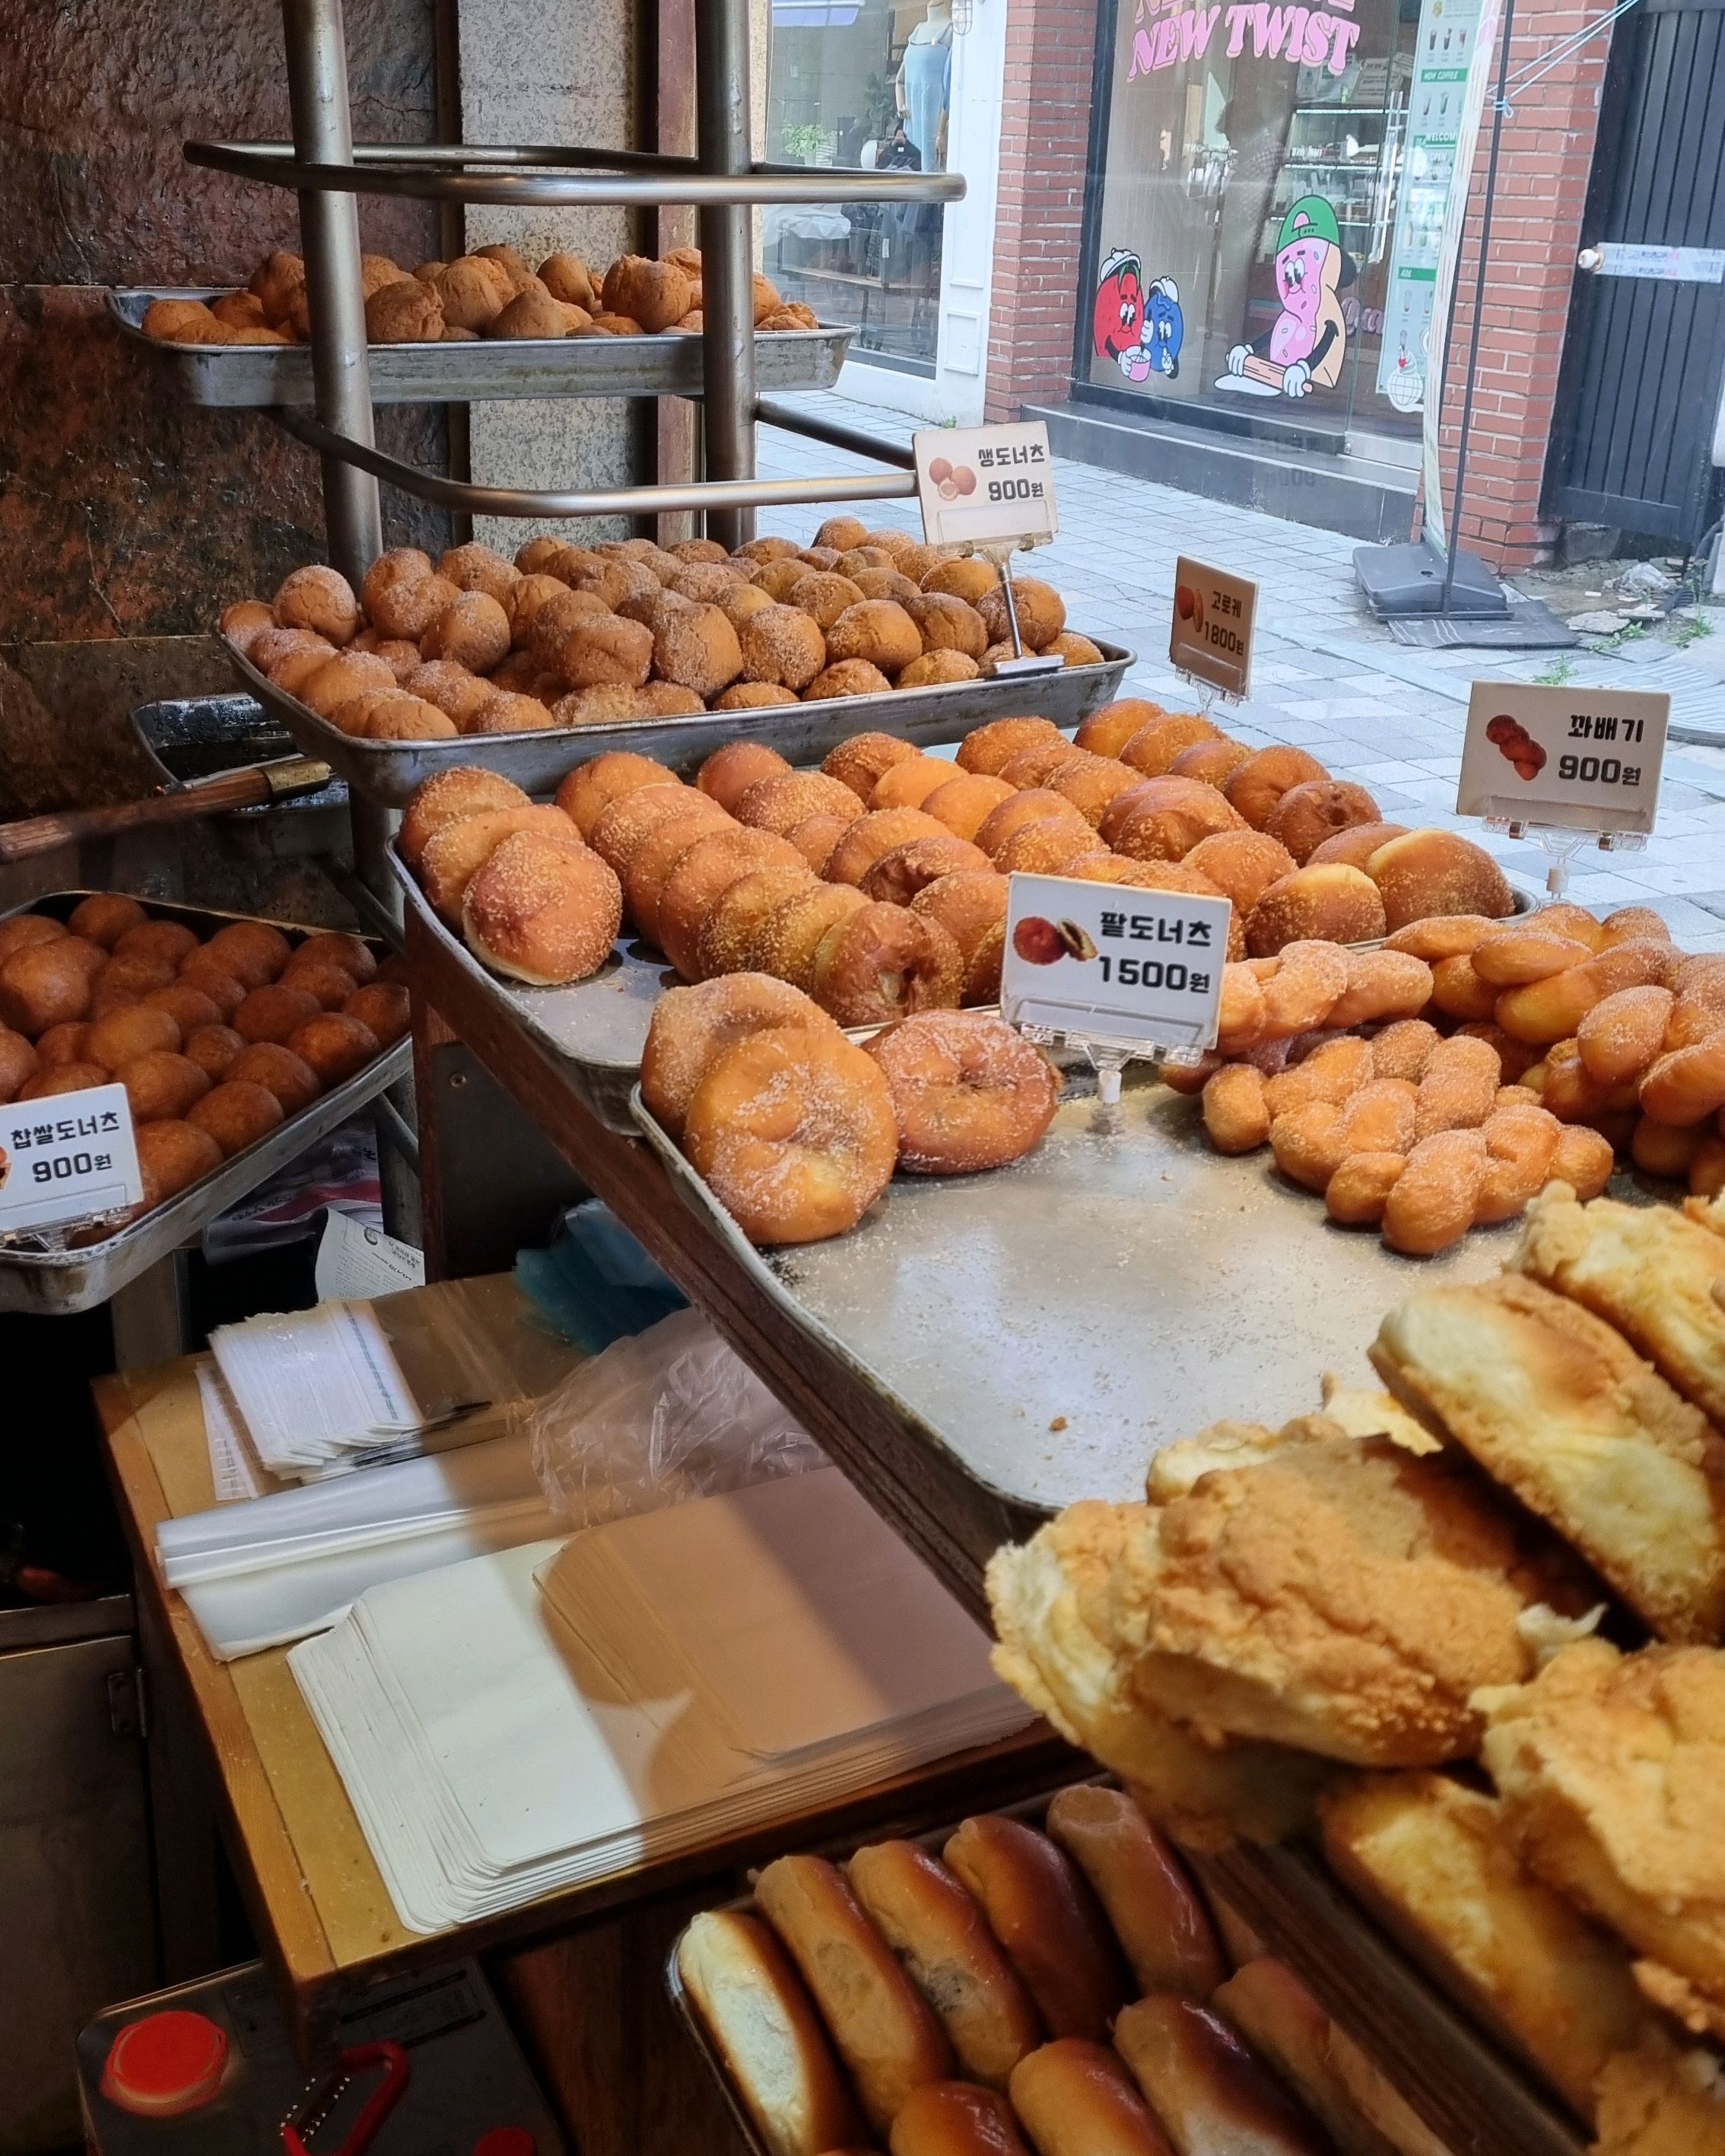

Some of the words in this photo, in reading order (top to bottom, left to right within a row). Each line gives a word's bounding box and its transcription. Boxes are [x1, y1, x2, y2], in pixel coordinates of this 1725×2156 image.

[1126, 5, 1221, 82] NEW
[1225, 3, 1360, 76] TWIST
[978, 443, 1045, 467] 생도너츠
[988, 478, 1044, 501] 900원
[1211, 590, 1242, 619] 고로케
[1205, 621, 1244, 656] 1800원
[1568, 714, 1644, 743] 꽈배기
[1558, 754, 1641, 786] 900원
[1100, 910, 1212, 948] 팥도너츠
[1098, 956, 1211, 994] 1500원
[11, 1111, 119, 1150] 찹쌀도너츠
[32, 1152, 113, 1183] 900원
